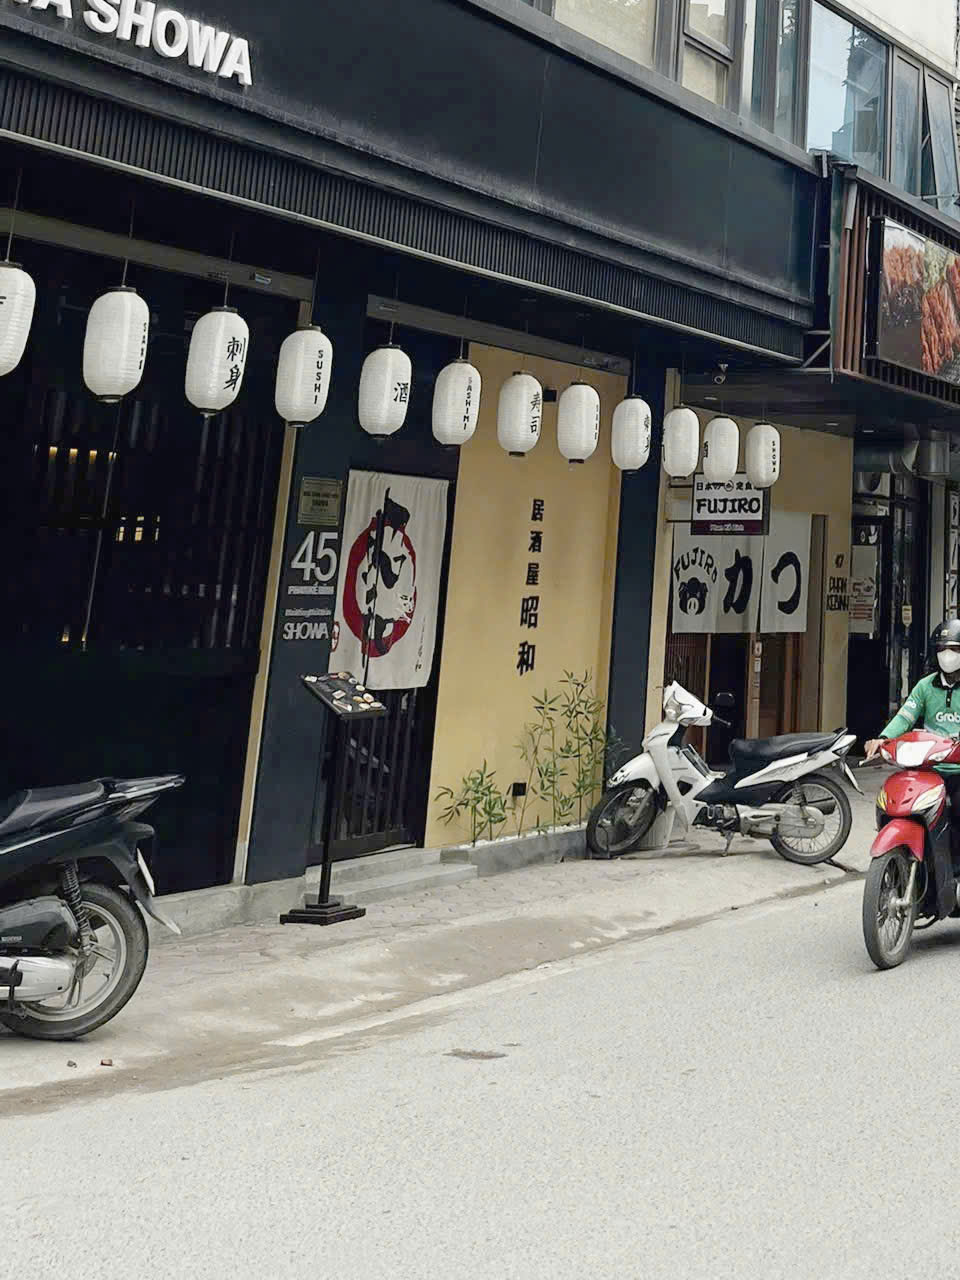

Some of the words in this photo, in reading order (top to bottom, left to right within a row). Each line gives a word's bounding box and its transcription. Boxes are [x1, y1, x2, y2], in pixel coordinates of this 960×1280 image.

[313, 349, 324, 405] SUSHI
[394, 382, 409, 403] 酒
[463, 377, 473, 430] SASHIMI
[695, 497, 761, 514] FUJIRO
[290, 531, 338, 582] 45
[673, 547, 718, 585] FUJIRO
[517, 499, 544, 676] 居酒屋昭和
[282, 622, 329, 640] SHOWA
[936, 711, 960, 723] Grab
